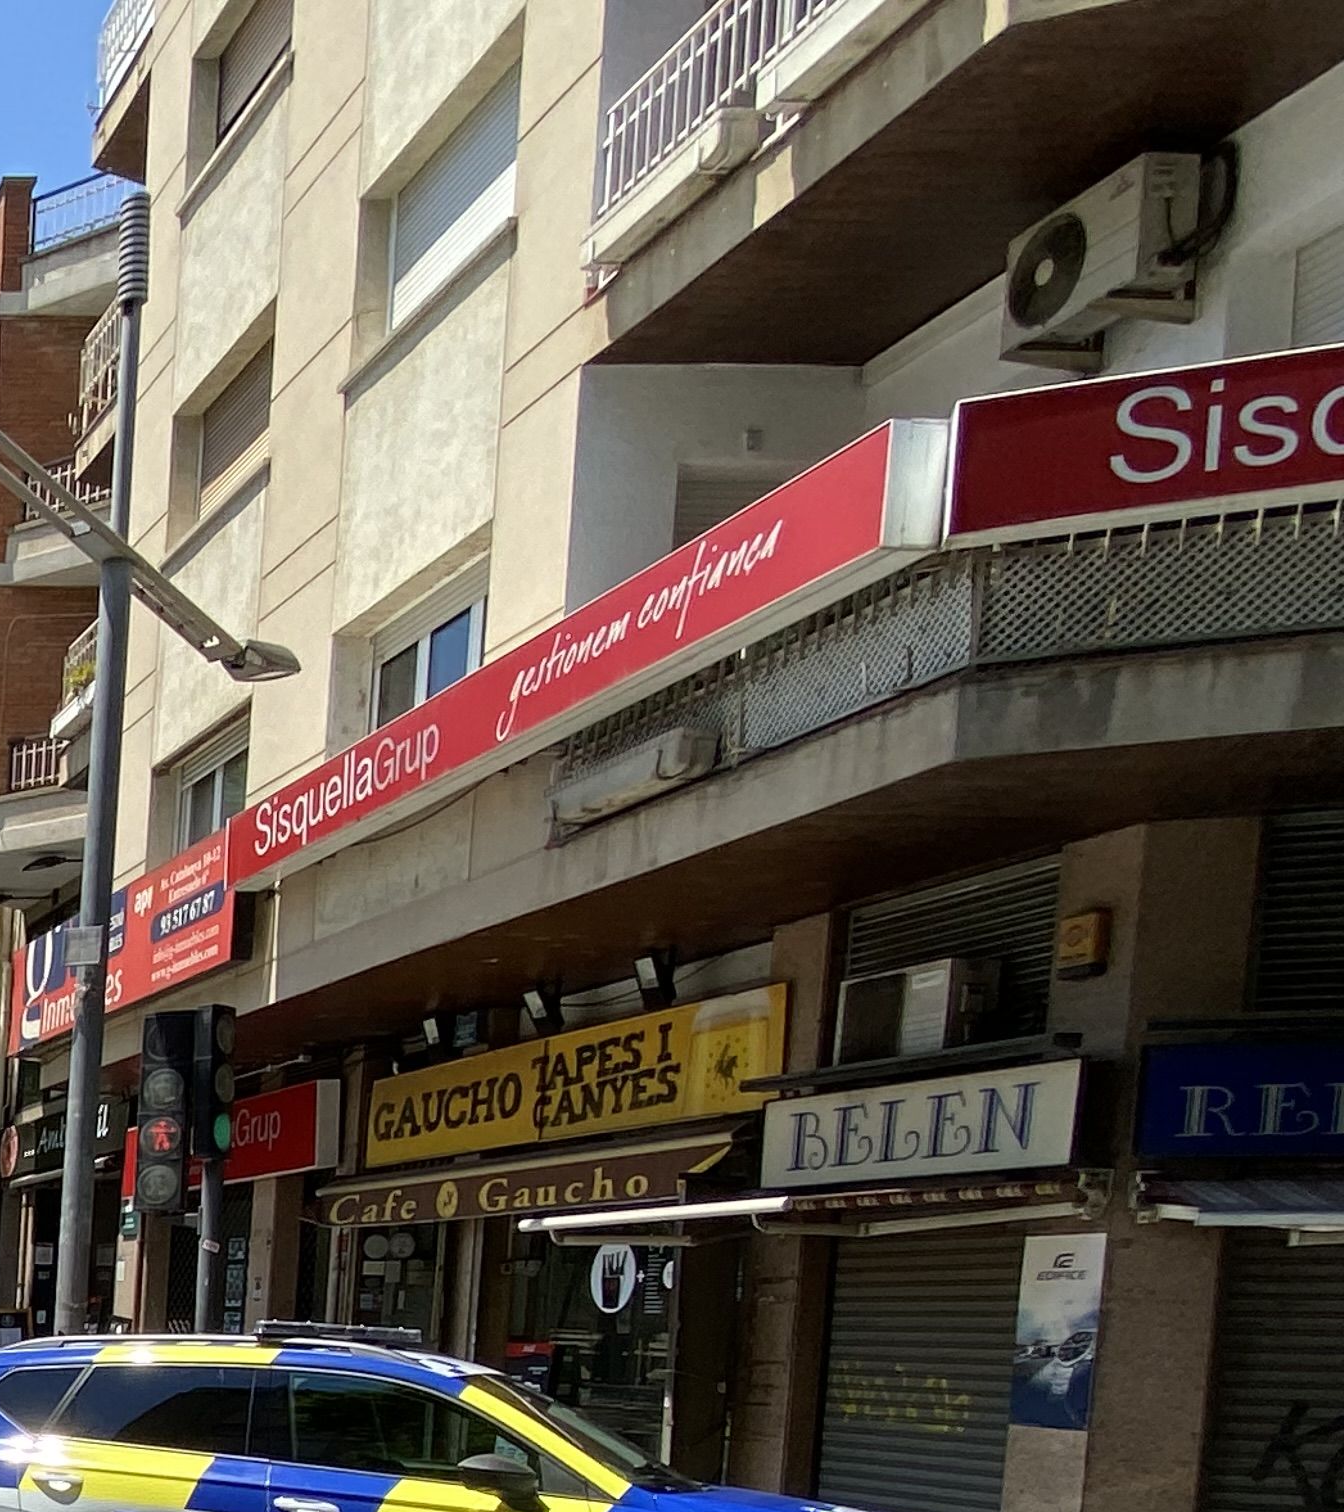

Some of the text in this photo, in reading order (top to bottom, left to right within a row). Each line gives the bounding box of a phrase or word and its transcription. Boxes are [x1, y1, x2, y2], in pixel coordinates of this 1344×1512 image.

[495, 611, 632, 742] gestionem
[254, 723, 440, 856] SisquellaGrup
[531, 1021, 673, 1093] TAPES I
[373, 1072, 523, 1142] GAUCHO
[532, 1062, 681, 1131] CANYES
[785, 1081, 1042, 1172] BELEN
[329, 1166, 650, 1225] Cafe Gaucho
